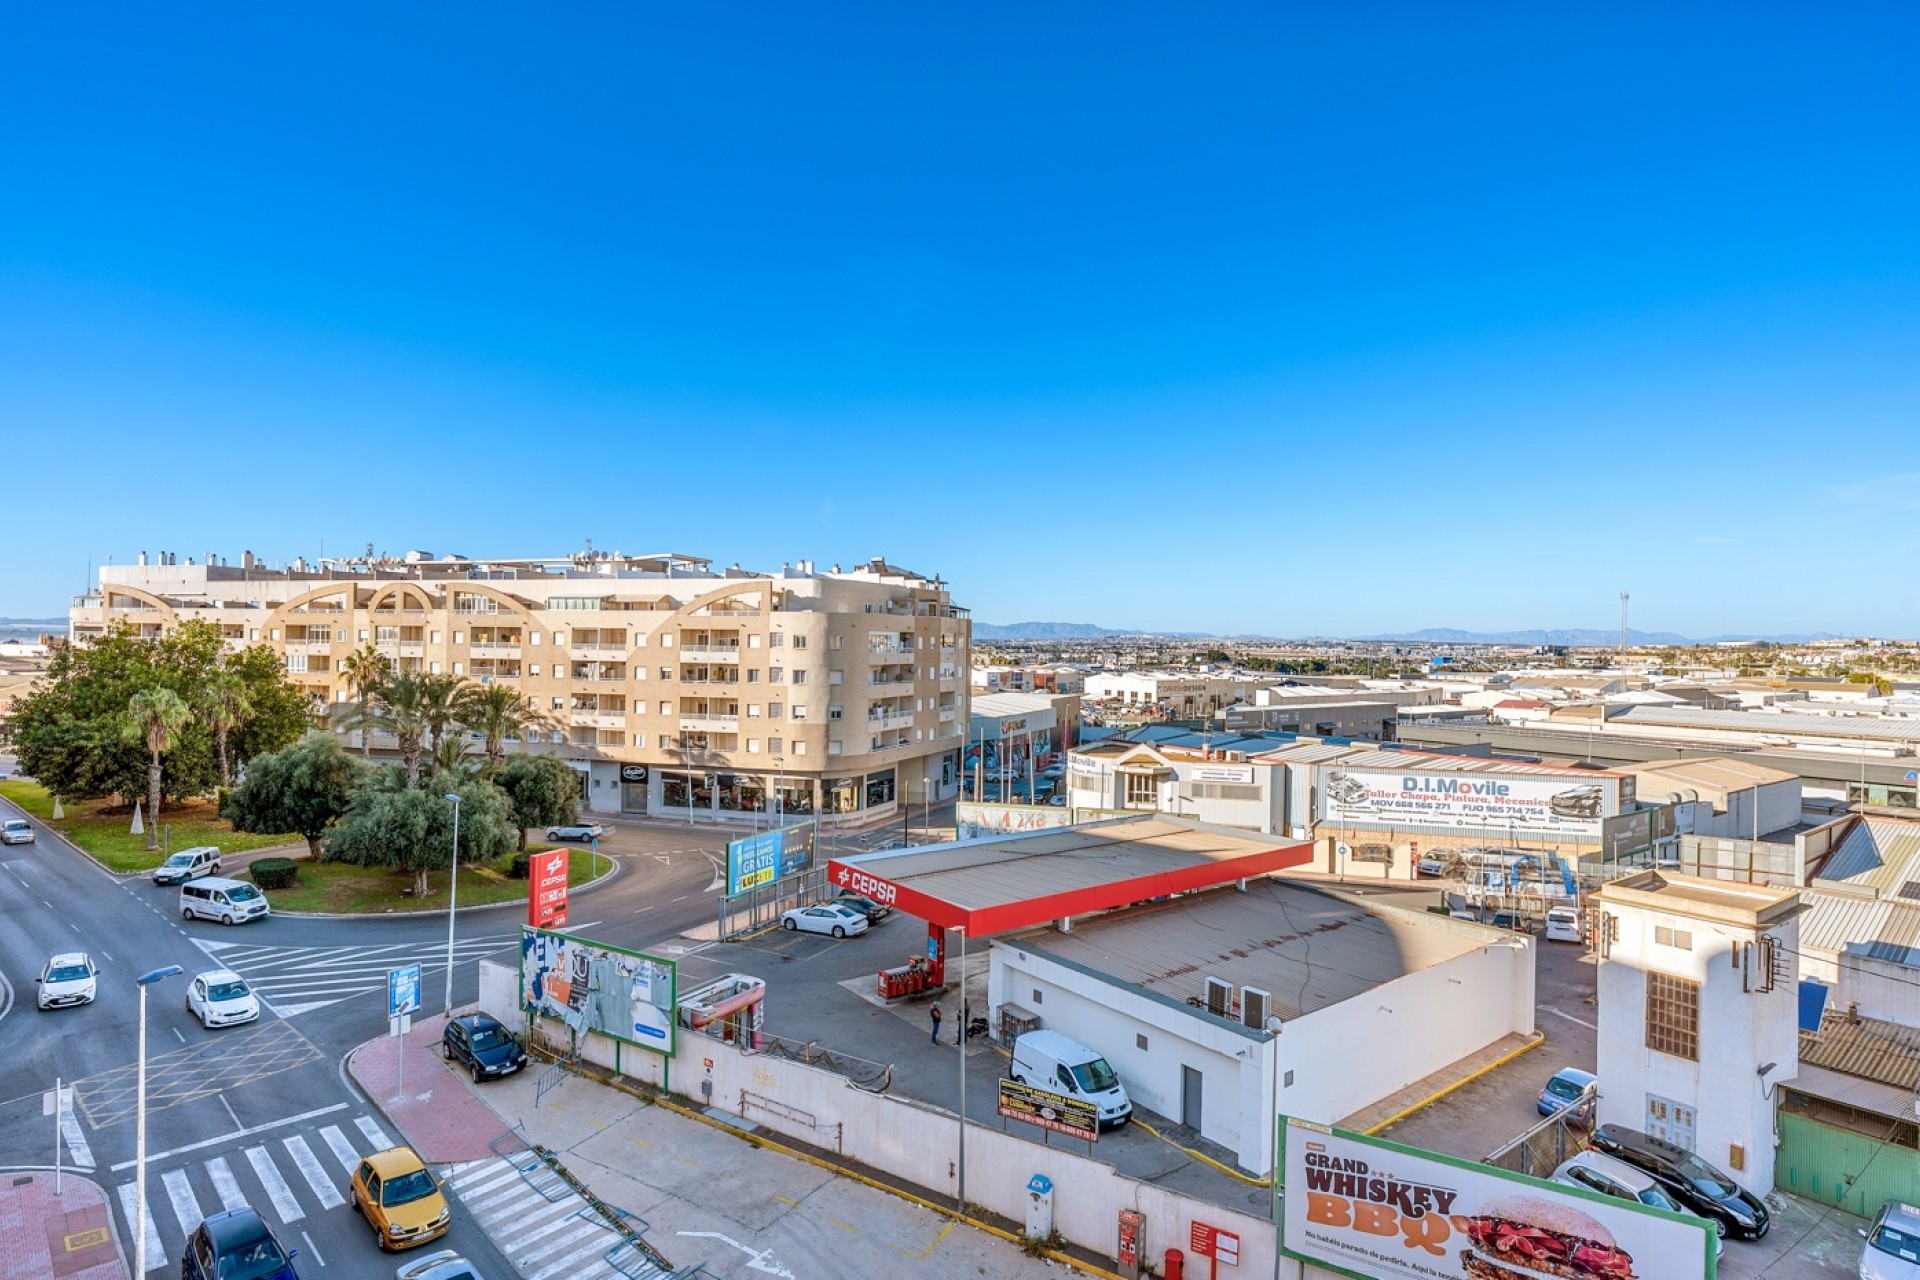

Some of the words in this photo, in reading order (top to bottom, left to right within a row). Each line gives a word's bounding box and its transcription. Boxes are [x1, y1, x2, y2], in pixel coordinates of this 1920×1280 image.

[1364, 789, 1397, 799] Taller
[1401, 791, 1440, 802] Chapa,
[1444, 793, 1491, 804] Pintura,
[1403, 777, 1509, 796] D.I.Movile
[1370, 799, 1394, 807] MOV
[1462, 804, 1484, 812] FIJO
[1505, 806, 1523, 814] 714
[1525, 807, 1544, 815] 754
[742, 853, 774, 873] GRATIS
[541, 873, 567, 888] CEPSA
[851, 872, 897, 904] CEPSA
[1305, 1152, 1369, 1175] GRAND
[1305, 1166, 1458, 1219] WHISKEY
[1307, 1191, 1451, 1257] BBQ
[1305, 1230, 1316, 1240] No
[1316, 1232, 1341, 1247] habéis
[1341, 1239, 1369, 1256] parado
[1369, 1247, 1379, 1259] de
